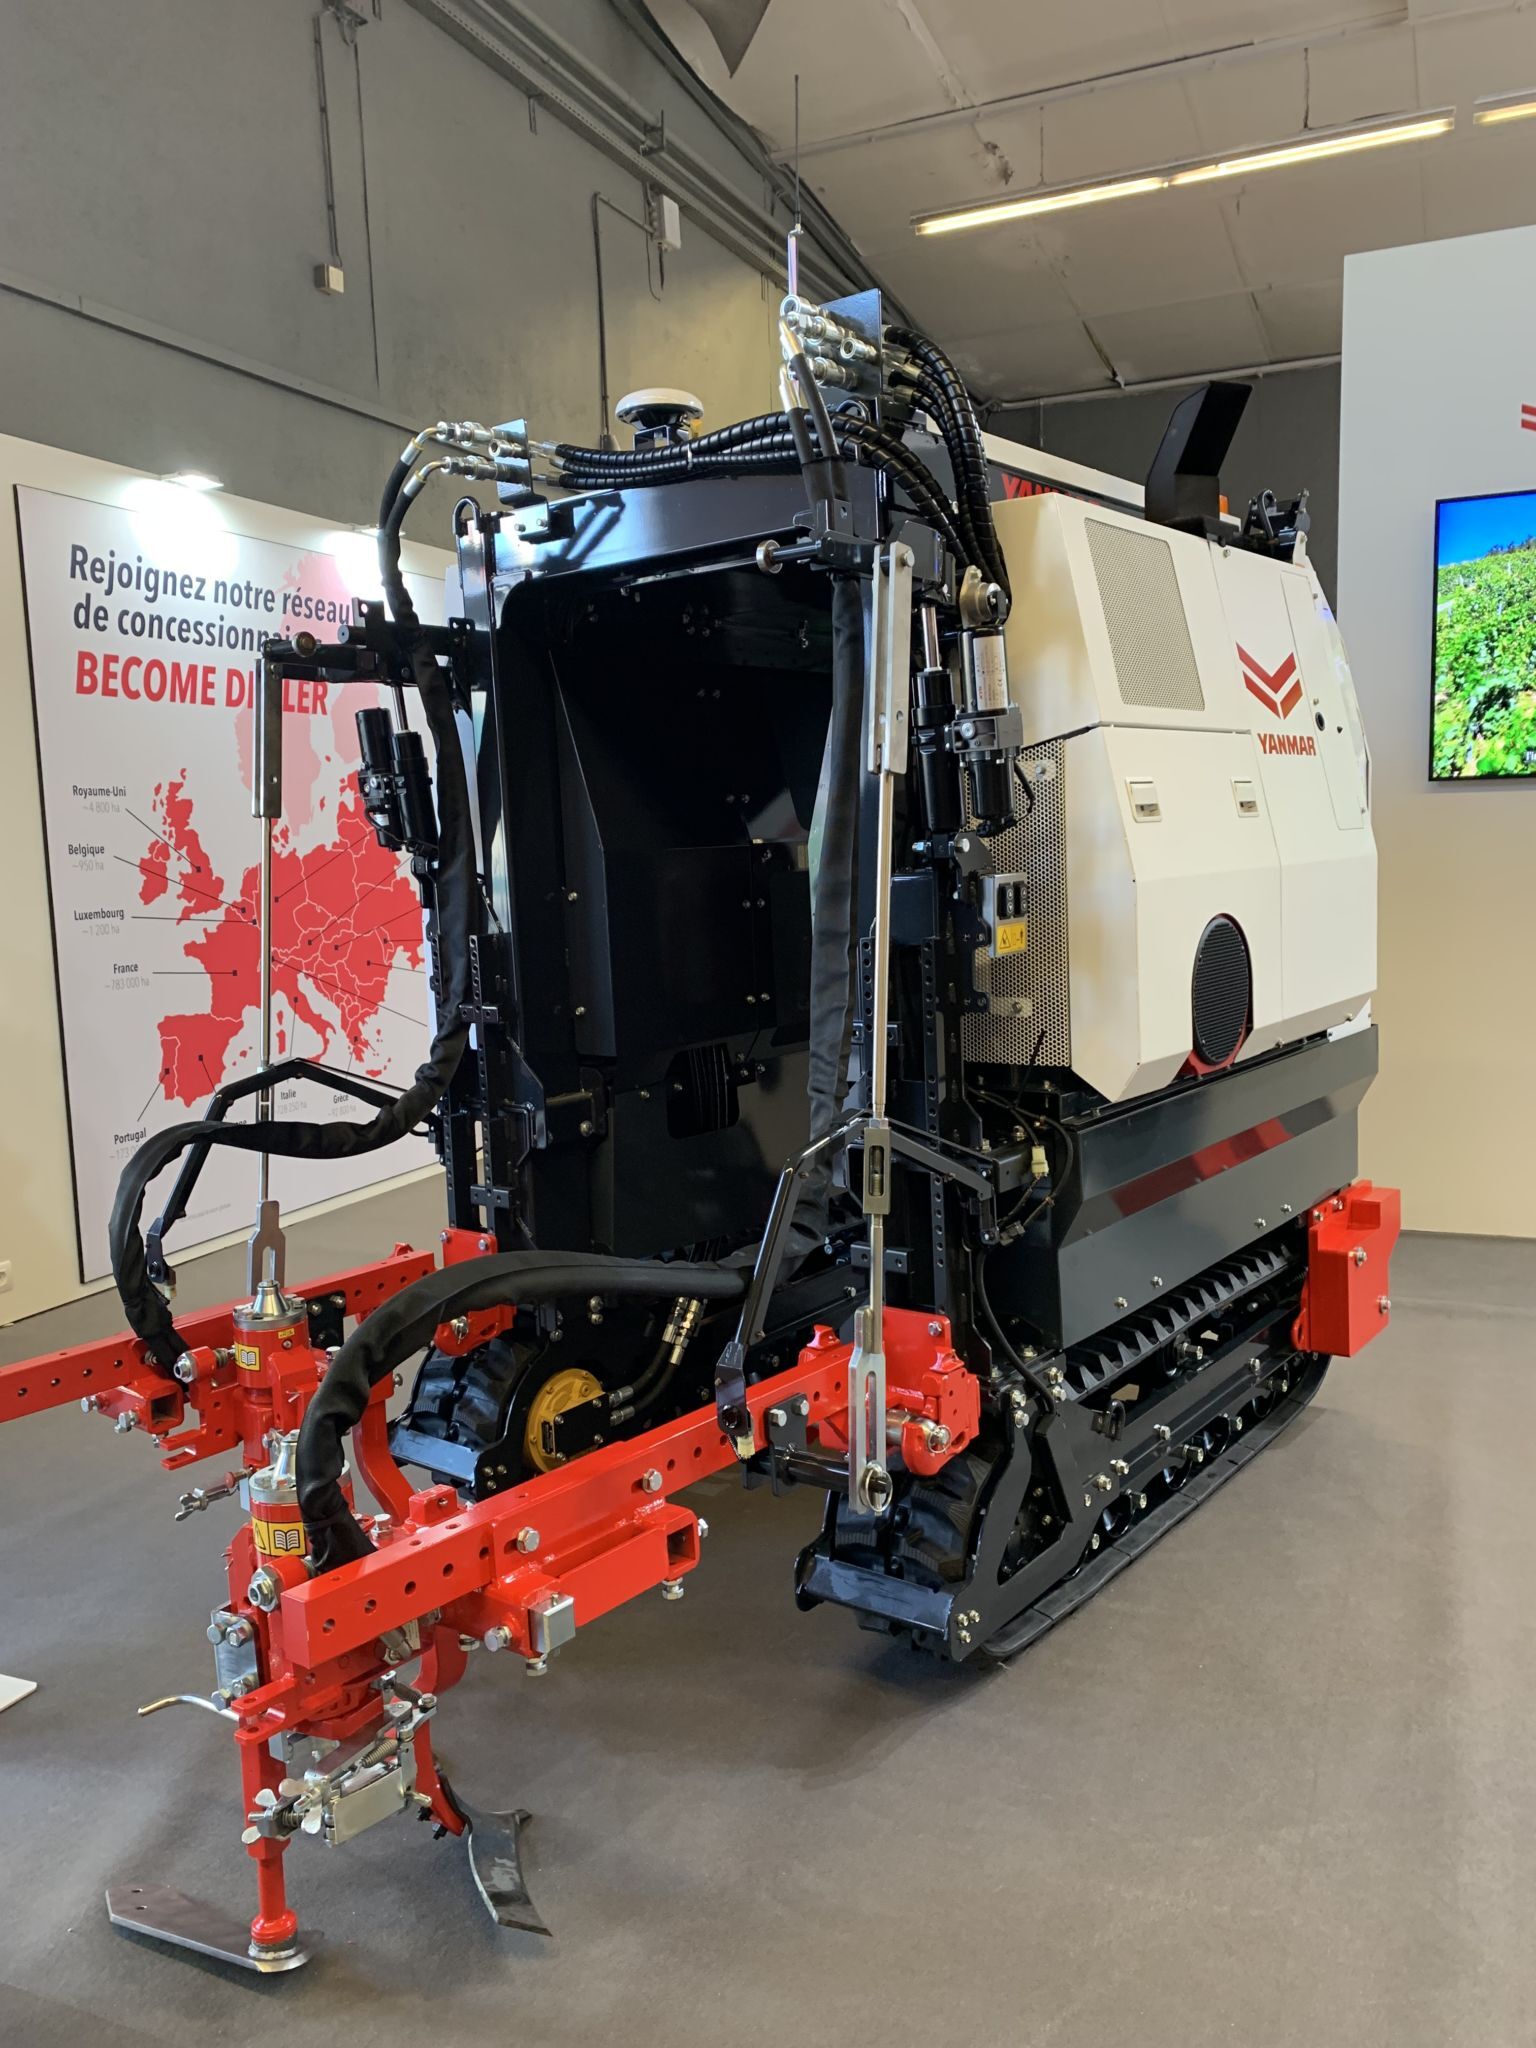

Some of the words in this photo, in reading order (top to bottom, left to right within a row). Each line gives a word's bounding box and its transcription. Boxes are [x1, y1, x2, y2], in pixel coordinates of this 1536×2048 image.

[70, 544, 206, 603] Rejoignez
[214, 579, 275, 613] notre
[282, 587, 350, 624] réseau
[74, 592, 109, 632] de
[76, 650, 216, 706] BECOME
[225, 667, 328, 716] DLER
[1257, 732, 1317, 756] YANMAR
[72, 785, 127, 799] Royaume-Uni
[68, 843, 105, 857] Belgique
[74, 908, 125, 921] Luxembourg
[113, 963, 139, 974] France
[280, 1089, 296, 1100] Italie
[333, 1093, 349, 1104] Grèce
[113, 1127, 147, 1145] Portugal
